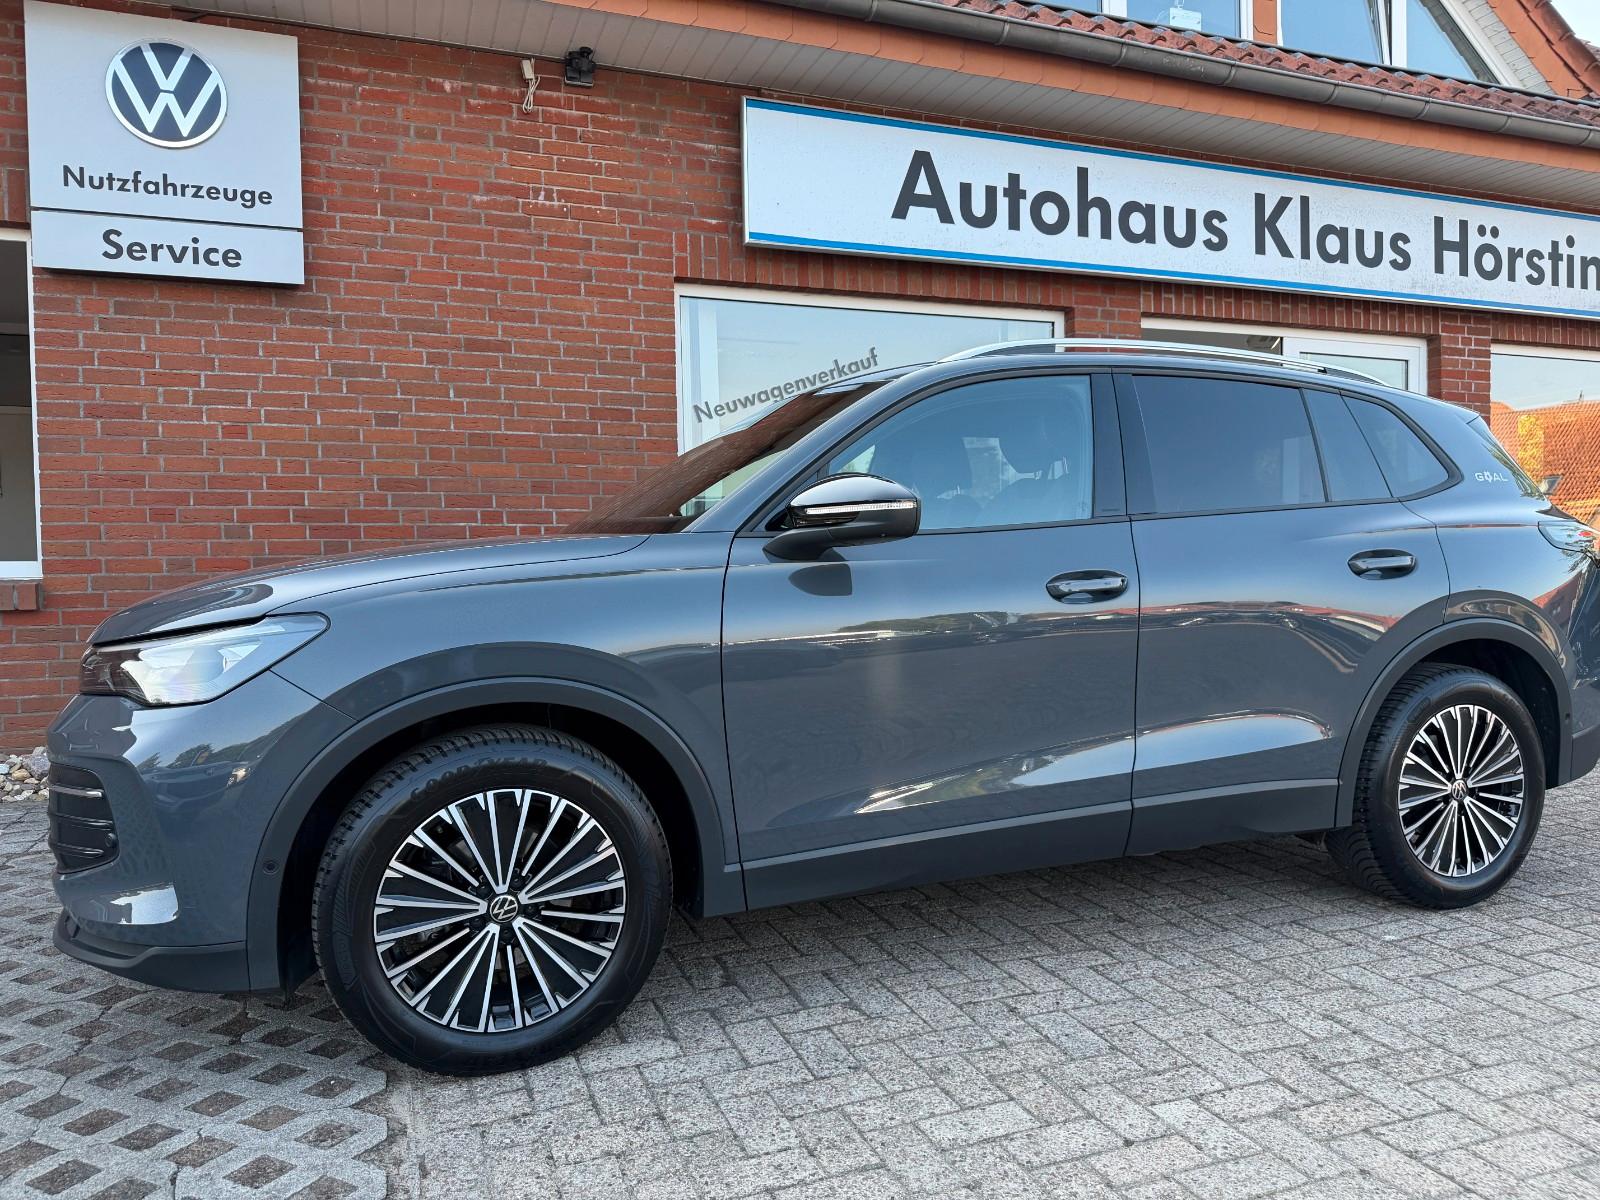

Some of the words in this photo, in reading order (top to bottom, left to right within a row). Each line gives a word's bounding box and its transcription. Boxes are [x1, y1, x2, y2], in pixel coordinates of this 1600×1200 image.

[109, 40, 223, 142] VW
[62, 164, 273, 209] Nutzfahrzeuge
[891, 149, 1228, 252] Autohaus
[1254, 192, 1412, 272] Klaus
[101, 228, 242, 268] Service
[692, 346, 879, 424] Neuwagenverkauf
[1475, 471, 1508, 482] GOAL
